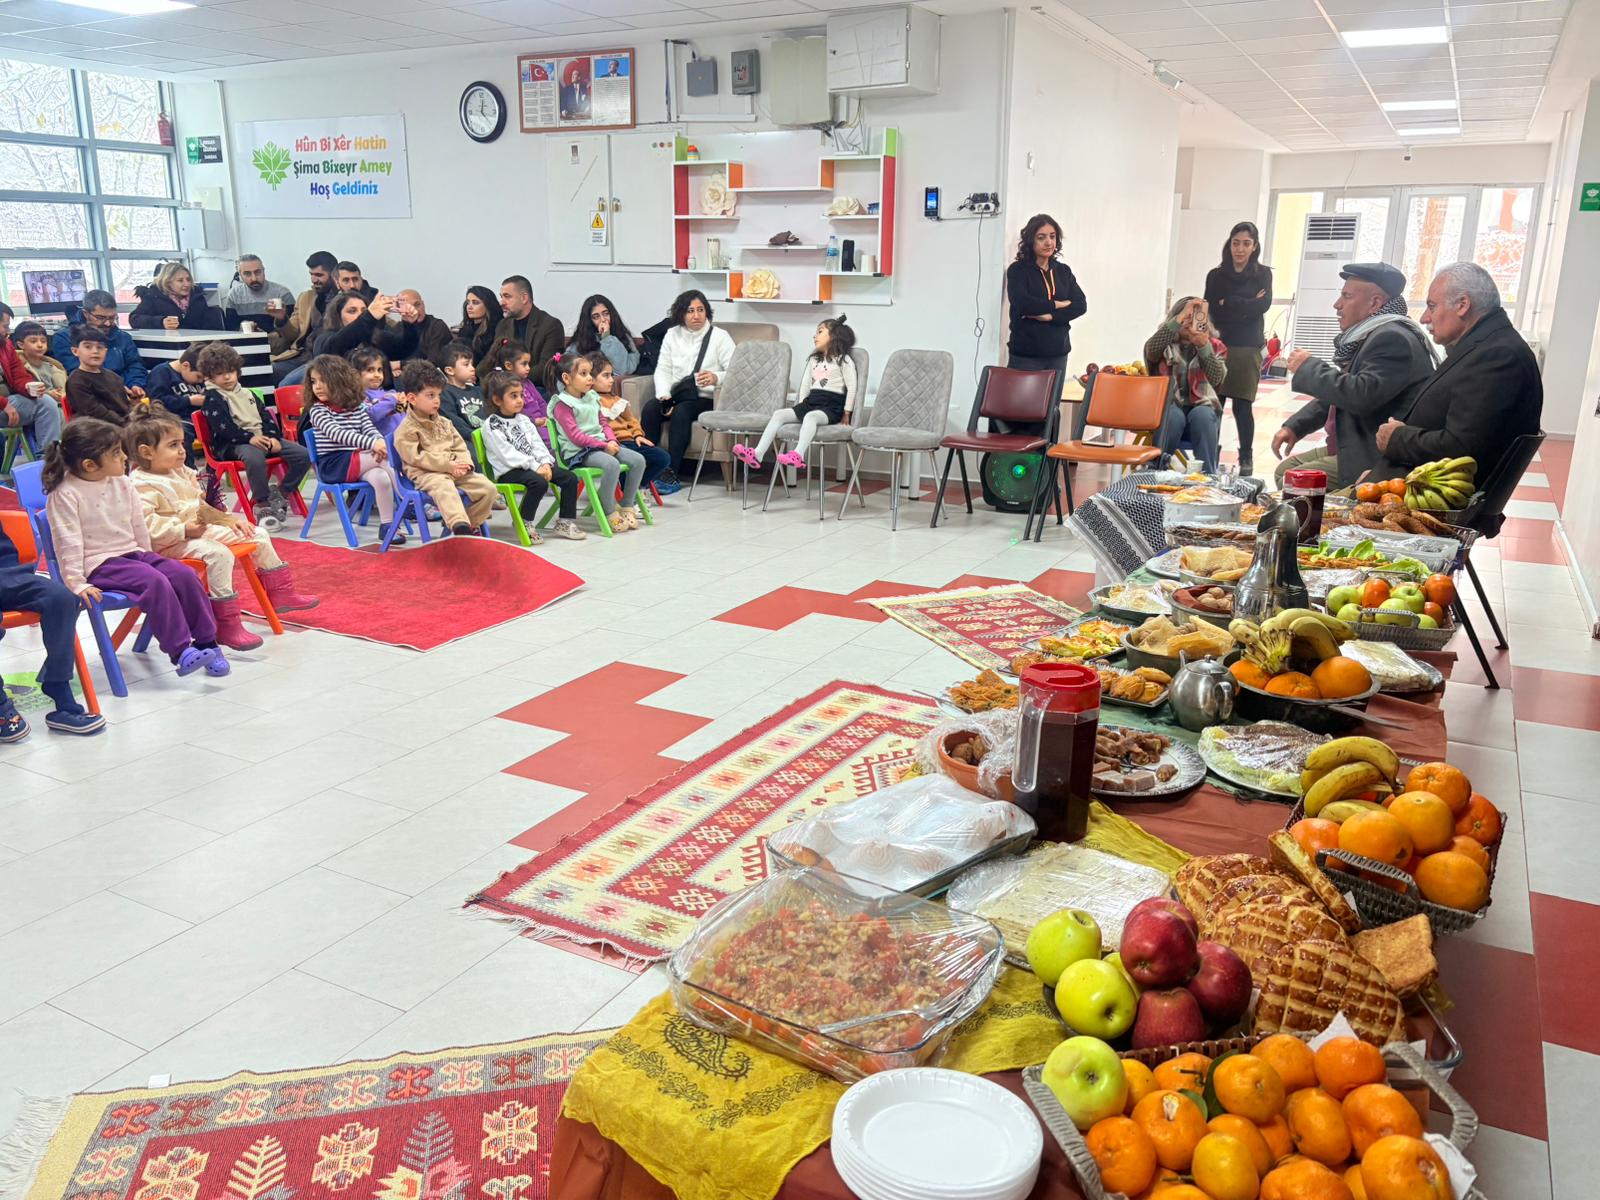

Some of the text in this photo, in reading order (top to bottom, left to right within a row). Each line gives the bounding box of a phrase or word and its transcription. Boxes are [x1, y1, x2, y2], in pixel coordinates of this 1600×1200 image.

[295, 134, 387, 152] Hûn Bi Xêr Hatin
[293, 159, 392, 179] Şima Bixeyr Amey
[310, 180, 379, 199] Hoş Geldiniz
